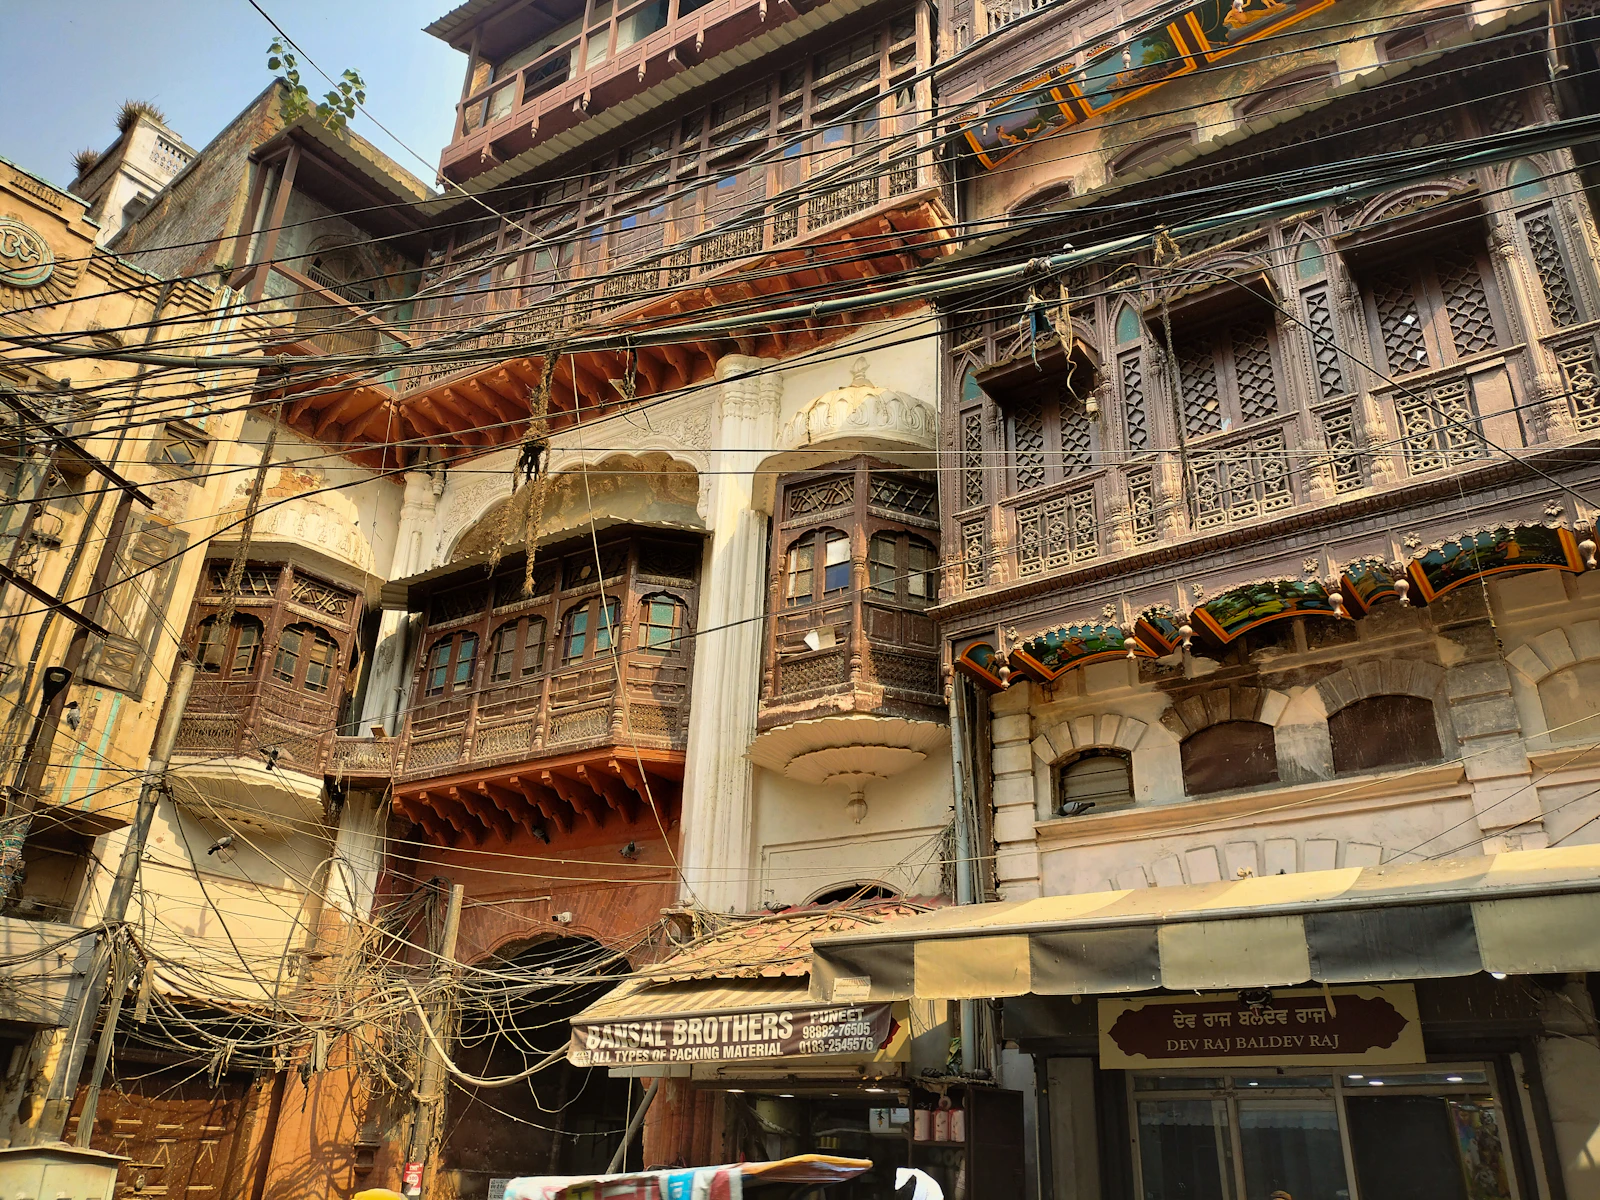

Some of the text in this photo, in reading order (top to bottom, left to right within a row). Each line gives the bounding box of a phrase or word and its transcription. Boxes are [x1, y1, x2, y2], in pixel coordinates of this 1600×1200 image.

[810, 1008, 864, 1024] PUNEET
[1172, 1009, 1197, 1029] ਦੇਵ
[1203, 1012, 1232, 1028] ਰਾਜ
[1295, 1007, 1327, 1024] ਰਾਜ
[586, 1011, 793, 1050] BANSAL BROTHERS
[802, 1022, 870, 1039] 98882-76505
[592, 1051, 612, 1064] ALL
[615, 1049, 649, 1062] TYPES
[652, 1048, 666, 1061] OF
[669, 1045, 719, 1061] PACKING
[722, 1042, 783, 1059] MATERIAL
[799, 1037, 873, 1054] 0183-2545576
[1166, 1033, 1340, 1053] DEV RAJ BALDEV RAJ
